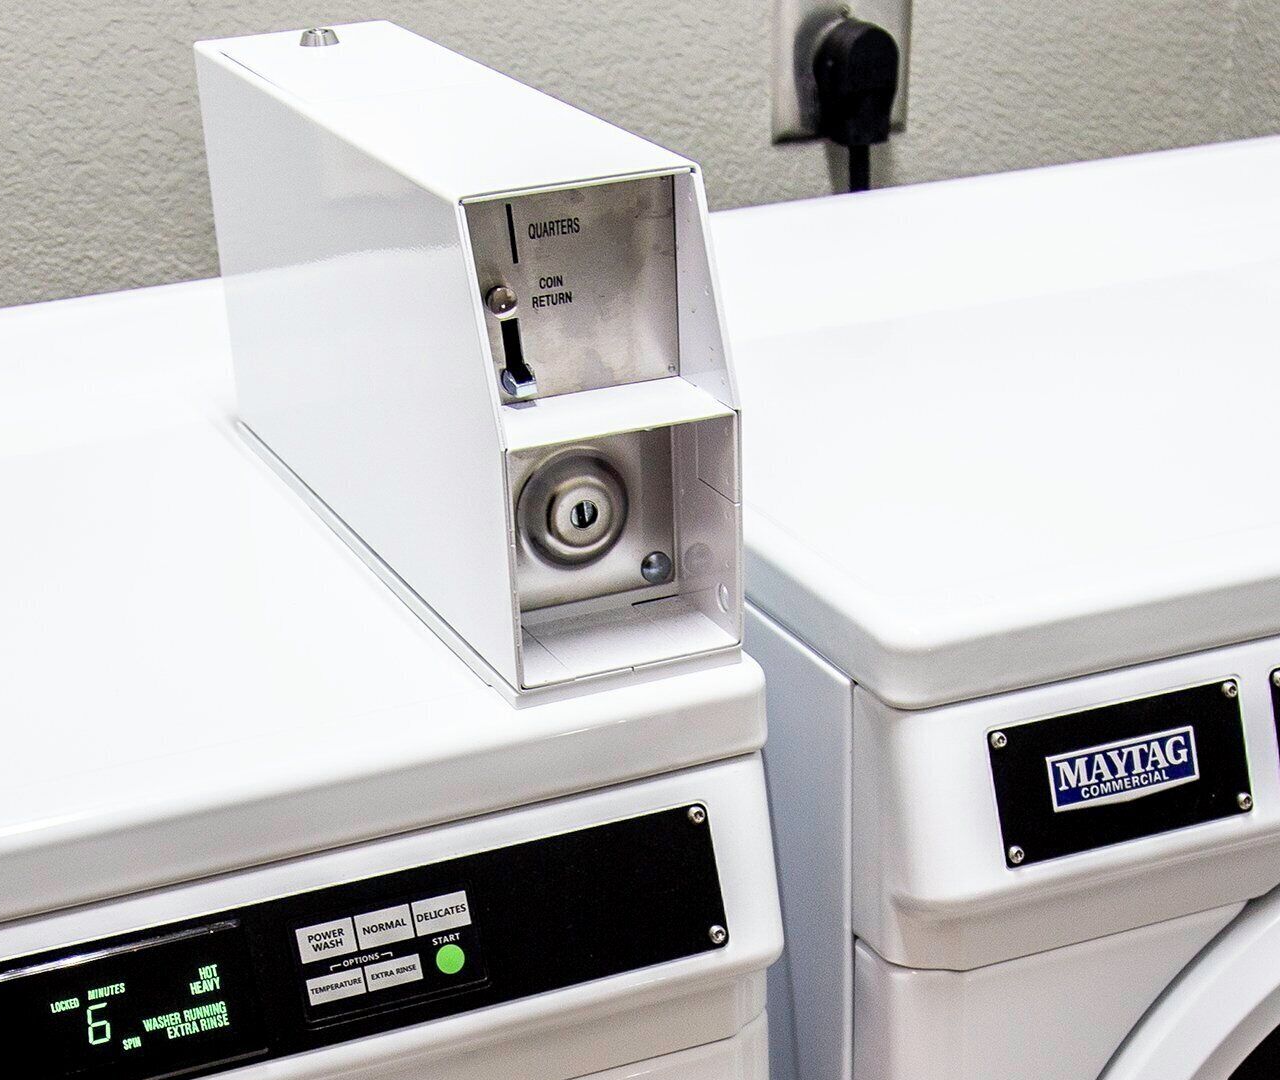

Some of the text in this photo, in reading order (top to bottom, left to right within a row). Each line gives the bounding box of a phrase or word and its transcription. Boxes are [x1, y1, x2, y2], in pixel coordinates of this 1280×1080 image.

[528, 217, 580, 240] QUARTERS
[539, 275, 564, 289] COIN
[532, 291, 573, 308] RETURN
[1055, 735, 1188, 791] MAYTAG
[1081, 769, 1170, 799] COMMERCIAL
[416, 903, 467, 923] DELICATES
[307, 927, 345, 944] POWER
[362, 918, 407, 936] NORMAL
[312, 938, 344, 953] WASH
[432, 932, 461, 946] START
[342, 952, 380, 967] OPTIONS
[198, 963, 218, 980] HOT
[370, 963, 417, 981] EXTRA RINSE
[87, 982, 126, 1000] MINUTES
[189, 977, 221, 996] HEAVY
[310, 976, 363, 995] TEMPERATURE
[50, 997, 80, 1014] LOCKED
[86, 1002, 111, 1045] 6
[142, 1001, 227, 1033] WASHER RUNNING
[166, 1013, 230, 1040] EXTRA RINSE
[122, 1036, 142, 1051] SPIN
